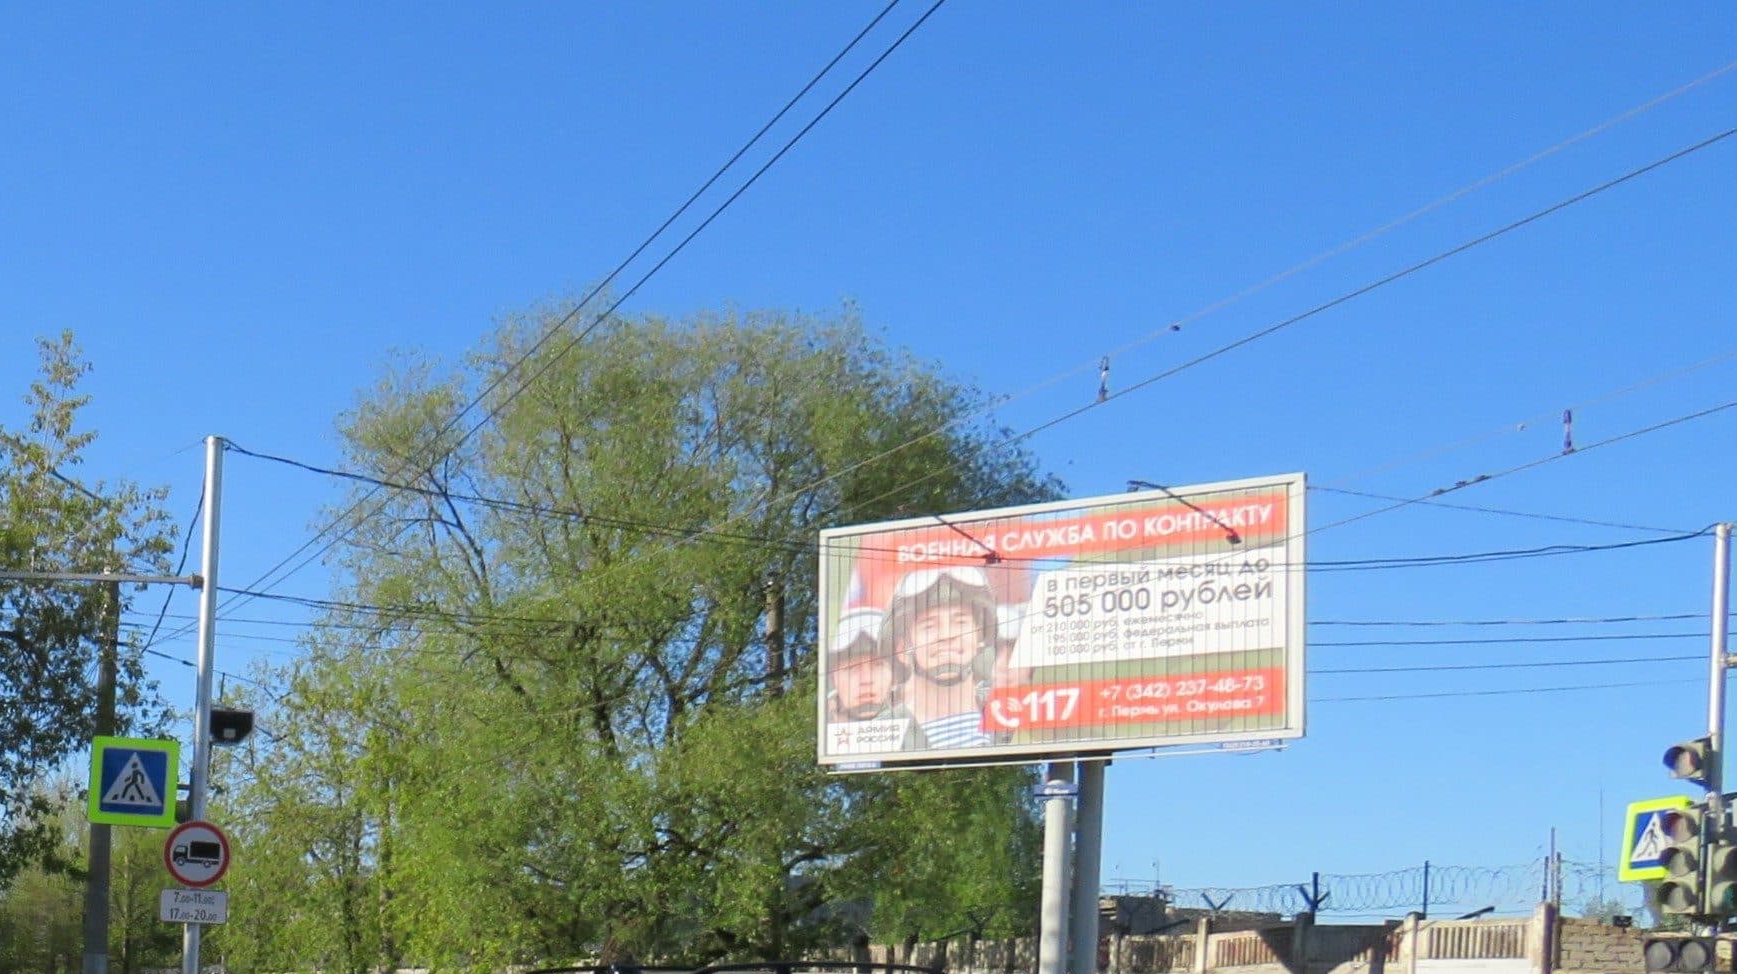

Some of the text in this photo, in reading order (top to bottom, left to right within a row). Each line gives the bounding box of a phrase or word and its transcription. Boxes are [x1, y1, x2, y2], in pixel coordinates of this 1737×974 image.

[897, 503, 1273, 563] ВОЕННАЯ СЛУЖБА ПО КОНТРАКТУ
[1065, 567, 1150, 593] первый
[1158, 562, 1230, 581] месяц
[1239, 558, 1270, 576] до
[1044, 577, 1272, 618] 505 000 рублей
[1021, 687, 1081, 723] 117
[1099, 684, 1121, 700] +7
[1125, 681, 1171, 701] (342)
[856, 734, 900, 744] РОССИИ
[858, 724, 901, 734] АРМИЯ
